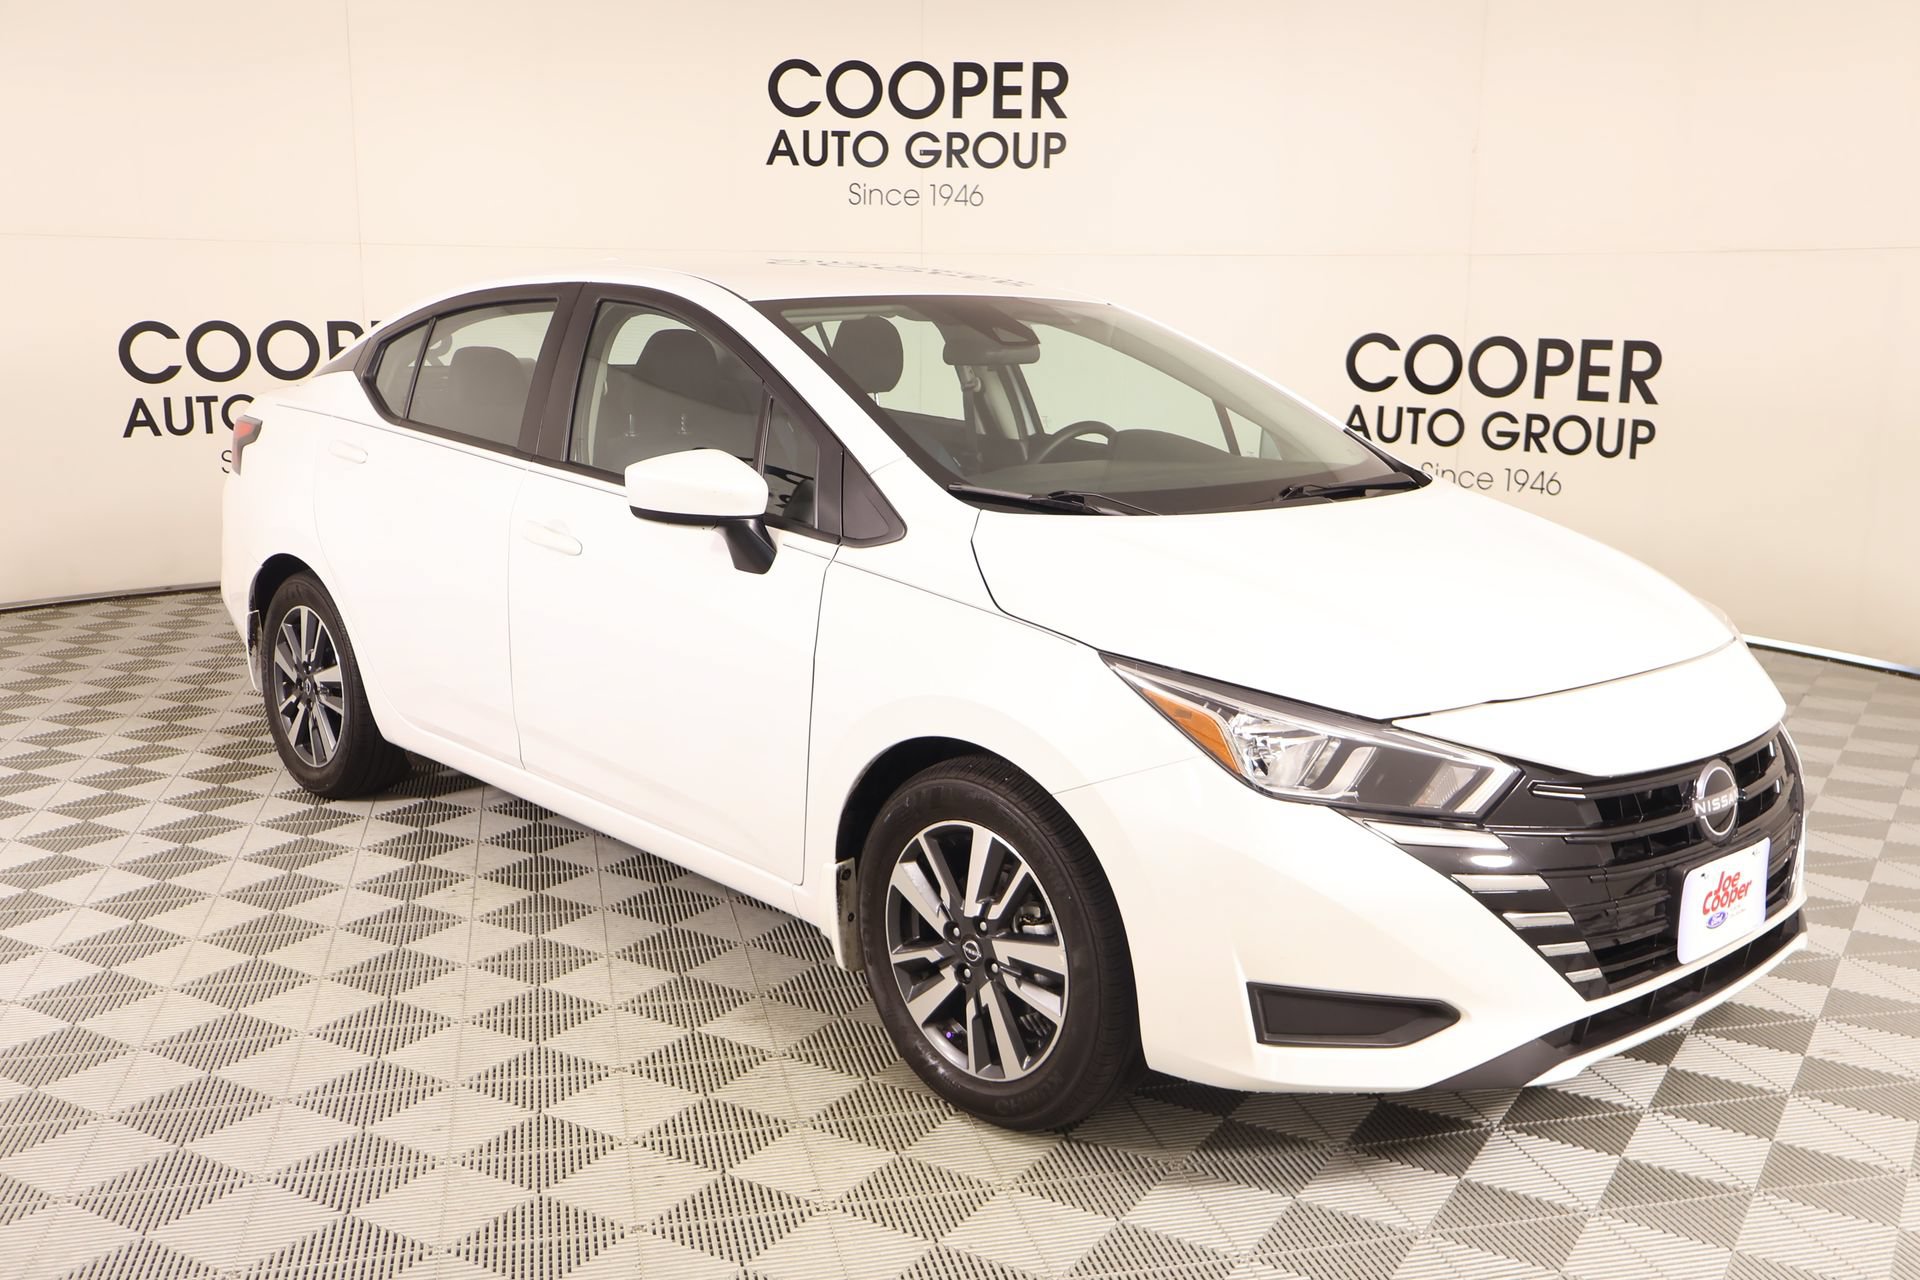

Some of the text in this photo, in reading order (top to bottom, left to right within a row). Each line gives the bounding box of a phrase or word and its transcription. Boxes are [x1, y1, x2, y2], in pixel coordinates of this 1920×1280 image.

[767, 58, 1069, 120] COOPER
[765, 129, 1067, 169] AUTO GROUP
[848, 182, 984, 207] Since 1946
[118, 320, 380, 384] COOP
[1346, 332, 1662, 405] COOPER
[1345, 404, 1656, 460] AUTO GROUP
[1504, 467, 1562, 496] 1946
[1702, 880, 1752, 915] Cooper
[1714, 871, 1741, 896] Joe
